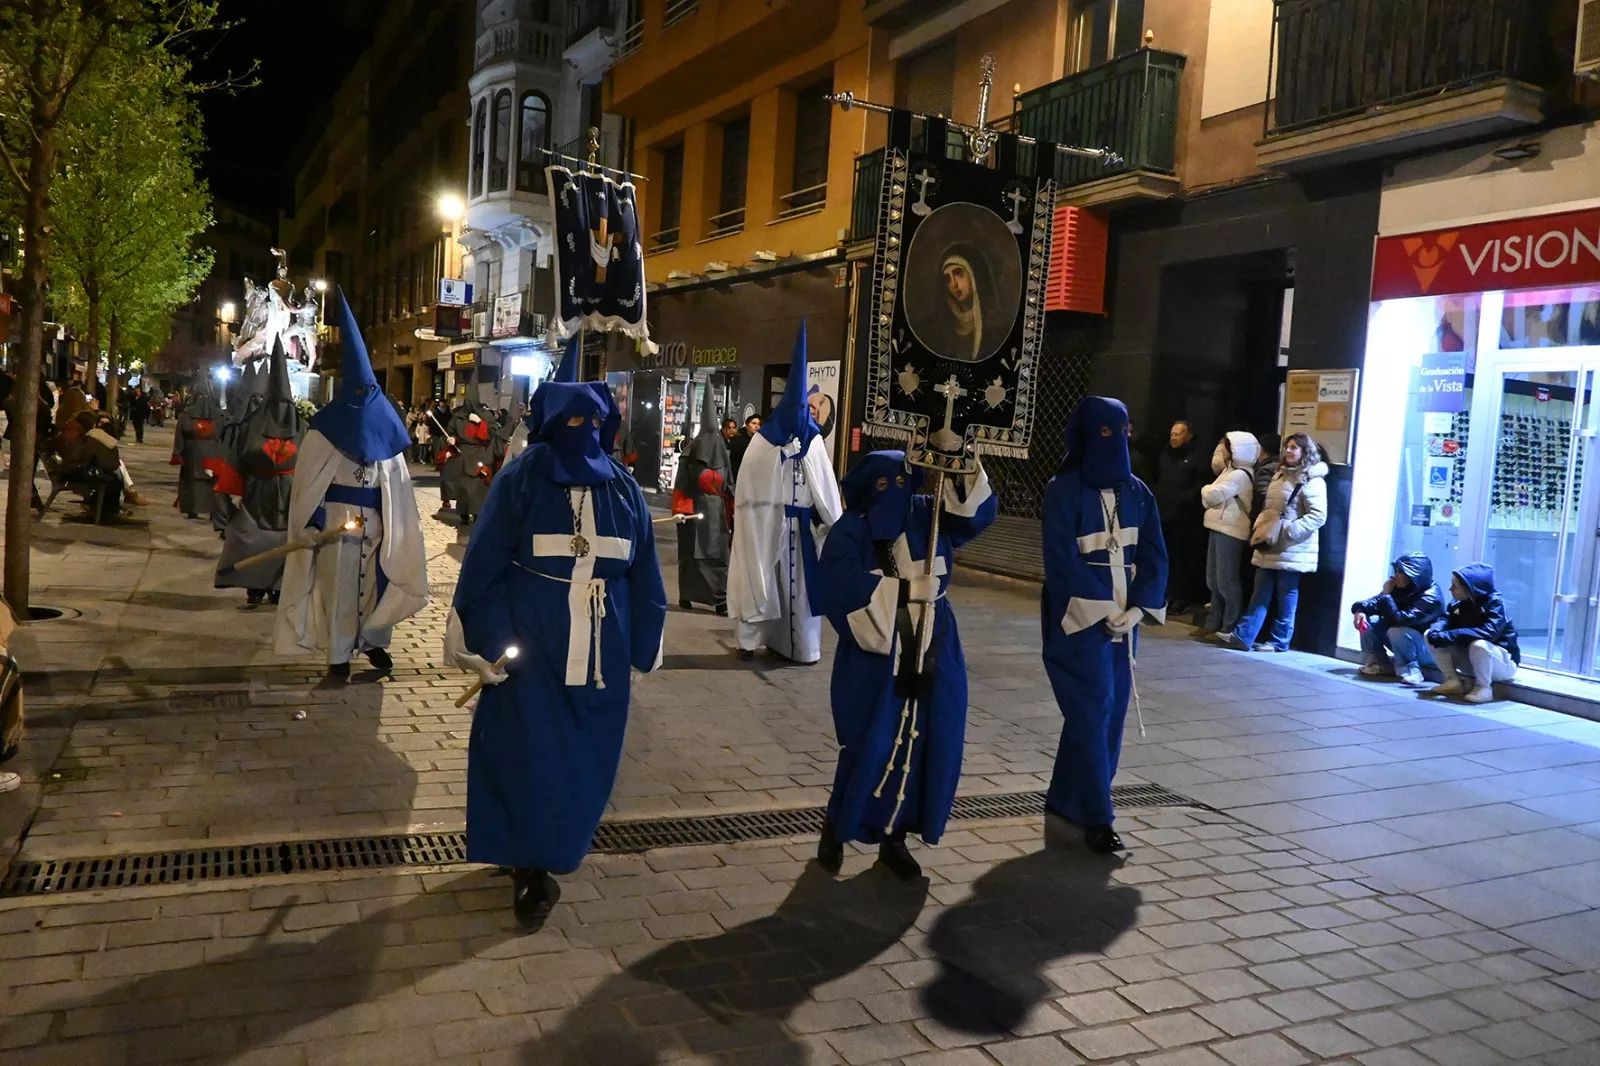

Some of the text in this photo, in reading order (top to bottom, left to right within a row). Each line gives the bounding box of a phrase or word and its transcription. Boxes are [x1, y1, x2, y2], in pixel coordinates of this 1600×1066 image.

[1459, 226, 1600, 276] VISION
[692, 345, 737, 365] farmacia
[809, 366, 837, 378] PHYTO
[1420, 366, 1464, 375] Graduación
[1433, 378, 1463, 392] Vista
